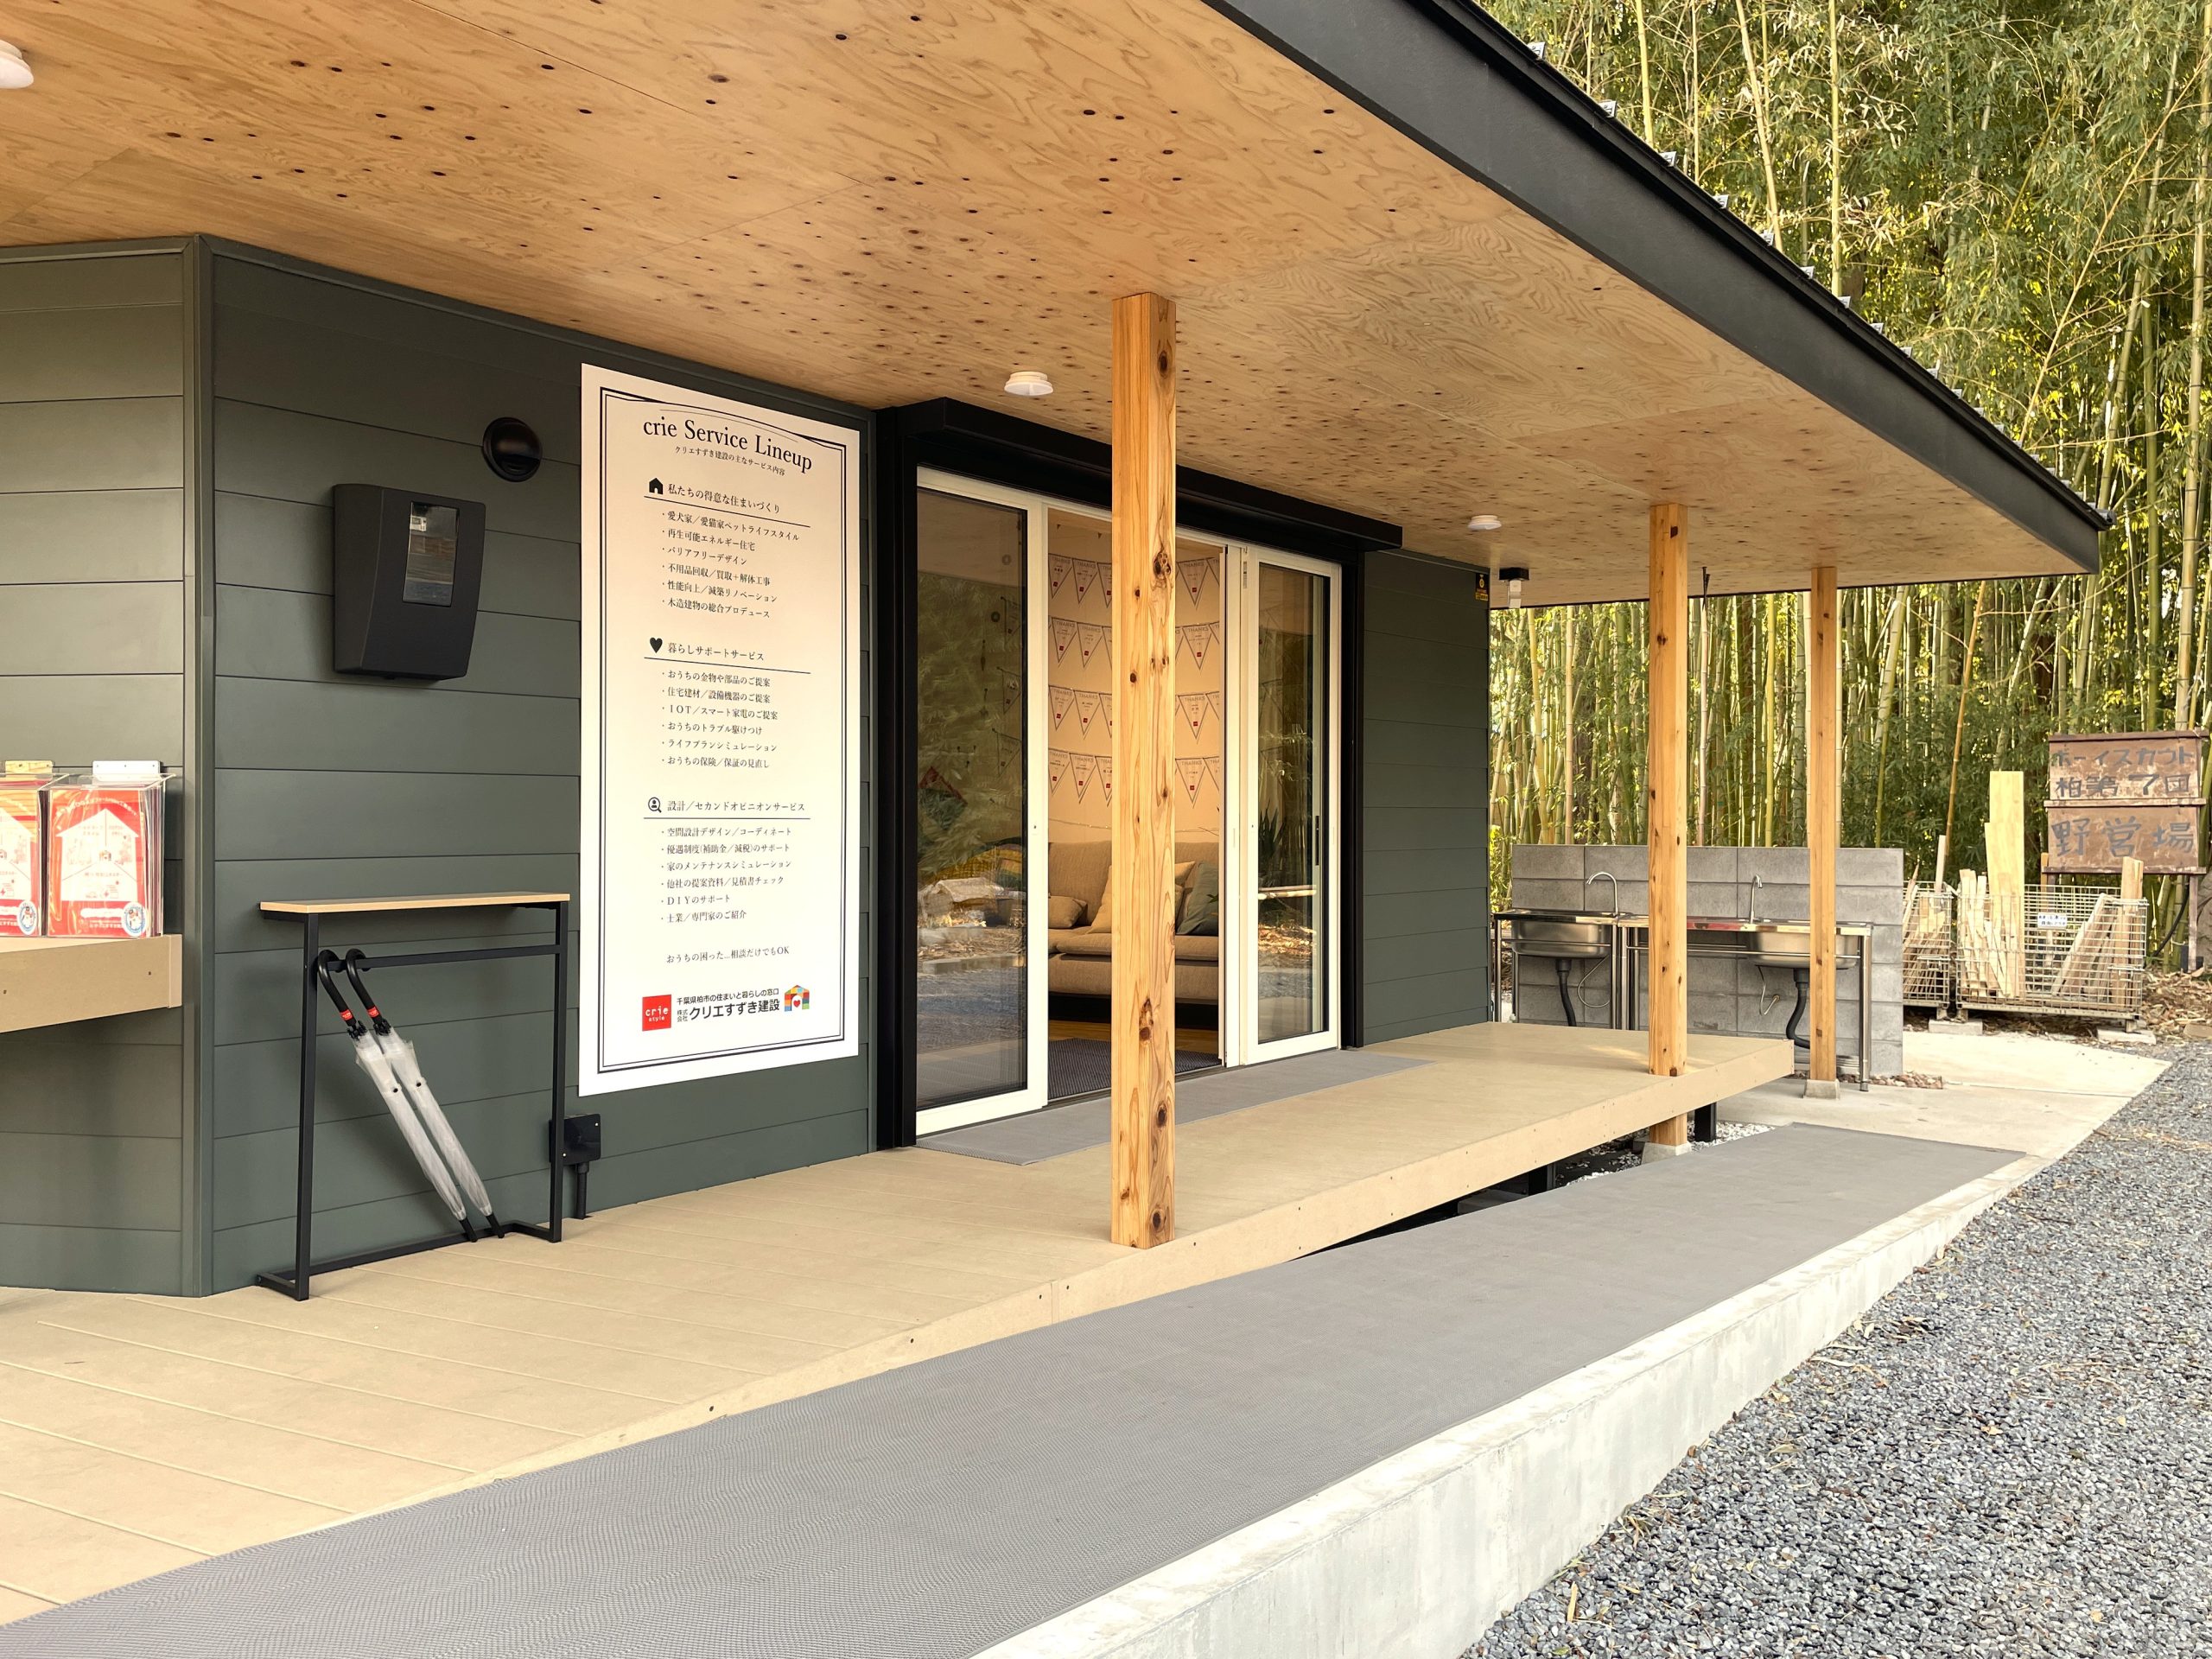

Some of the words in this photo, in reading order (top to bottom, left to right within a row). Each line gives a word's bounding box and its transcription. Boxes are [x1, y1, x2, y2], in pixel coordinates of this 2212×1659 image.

[643, 416, 677, 437] crie
[684, 419, 748, 450] Service
[754, 434, 812, 474] Lineup
[675, 446, 785, 476] クリエすずき建設の主なサービス内容
[668, 483, 780, 514] 私たちの得意な住まいづくり
[667, 528, 755, 552] 再生可能エネルギー住宅
[667, 547, 747, 565] バリアフリーデザイン
[667, 642, 765, 661] 暮らしサポートサービス
[2051, 746, 2193, 766] ボーイスカウト
[667, 800, 805, 811] 設計／セカンドオピニオンサービス
[2051, 815, 2194, 858] 野営場
[677, 988, 779, 1005] 千葉県柏市の住まいと暮らしの窓口
[645, 1005, 670, 1017] crie
[648, 1014, 665, 1023] style
[689, 999, 780, 1020] クリエすずき建設
